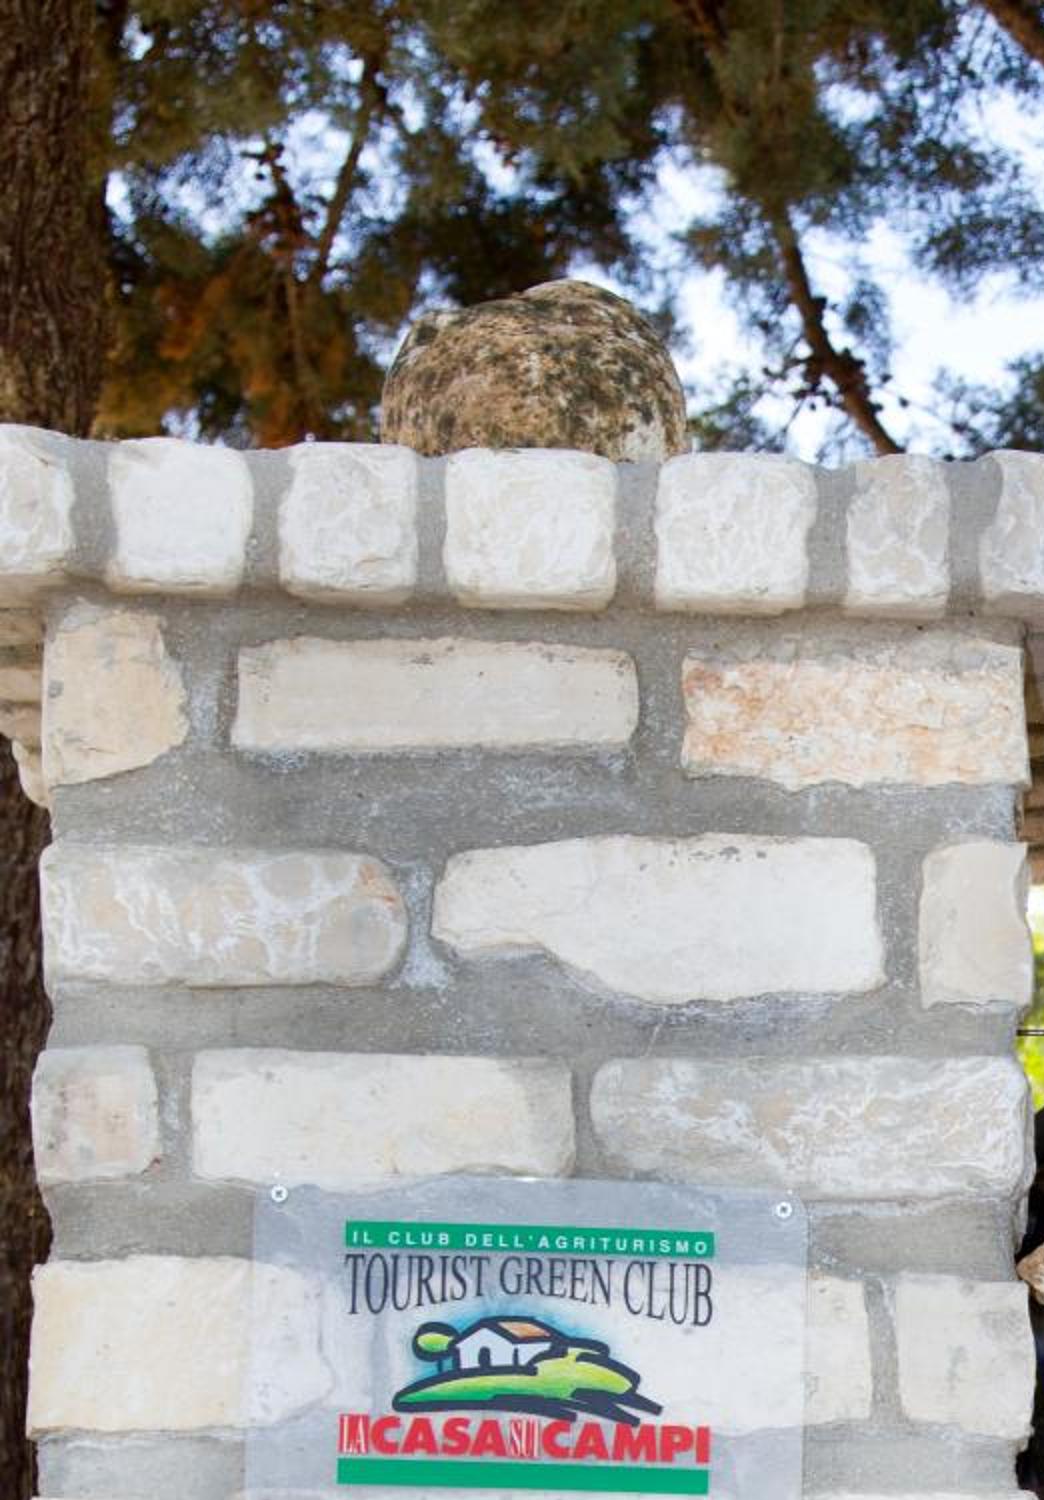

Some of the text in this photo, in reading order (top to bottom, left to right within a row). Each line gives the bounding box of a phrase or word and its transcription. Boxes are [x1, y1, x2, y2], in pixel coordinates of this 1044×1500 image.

[352, 1231, 707, 1254] IL CLUB DELL'AGRITURISMO
[345, 1253, 713, 1327] TOURIST GREEN CLUB
[340, 1414, 369, 1454] LA
[371, 1415, 507, 1456] CASA
[541, 1420, 710, 1463] CAMPI
